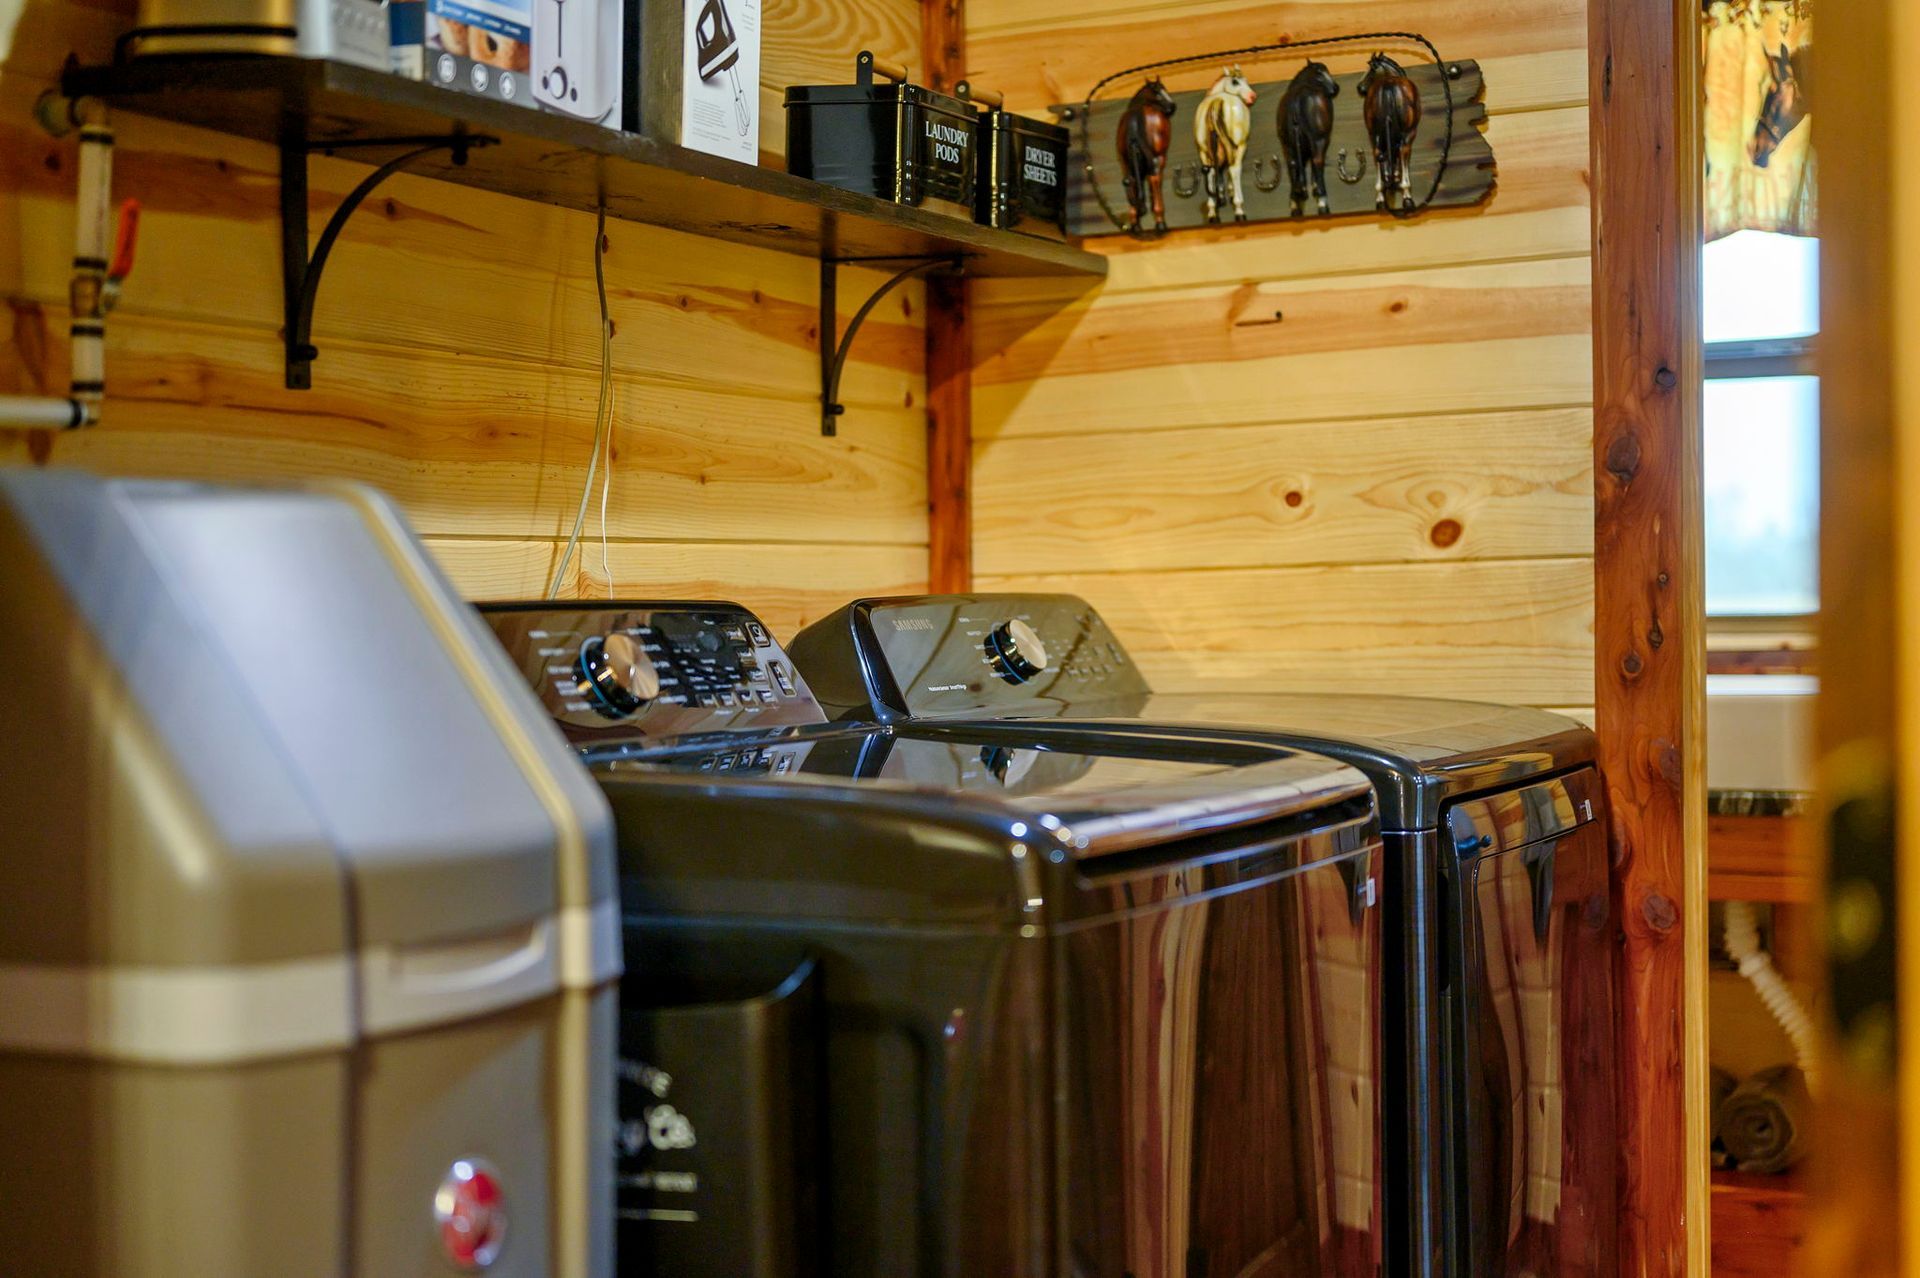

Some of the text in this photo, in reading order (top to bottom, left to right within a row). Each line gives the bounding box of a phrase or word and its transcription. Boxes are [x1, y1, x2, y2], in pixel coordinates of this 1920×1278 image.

[925, 120, 969, 148] LAUNDRY
[935, 142, 959, 164] PODS
[1025, 145, 1056, 168] DRYER
[1024, 163, 1057, 186] SHEETS
[892, 619, 934, 631] SAMSUNG
